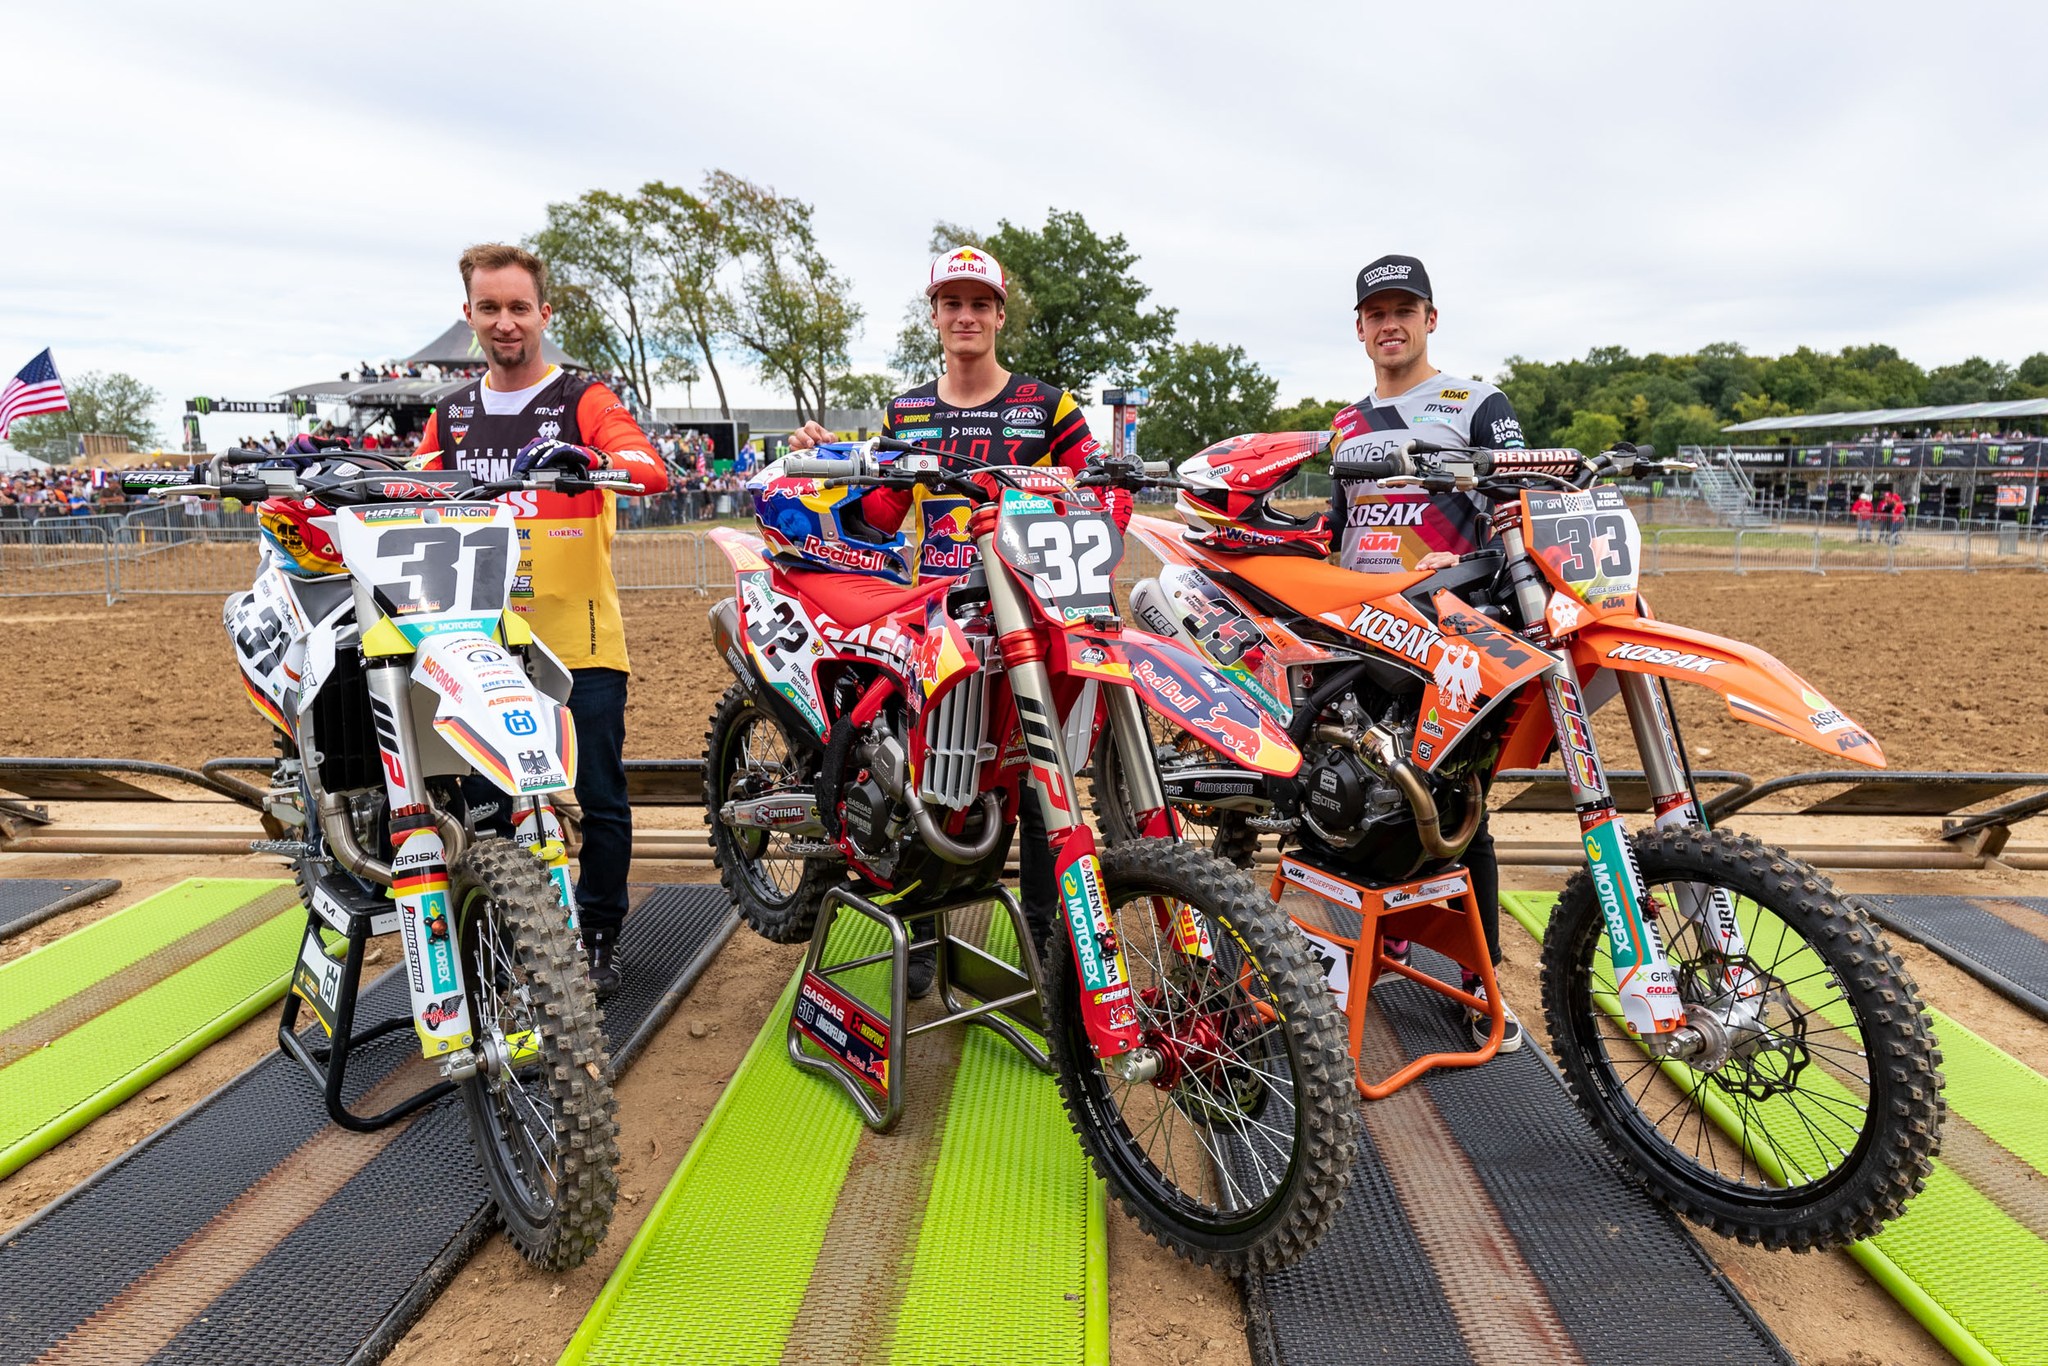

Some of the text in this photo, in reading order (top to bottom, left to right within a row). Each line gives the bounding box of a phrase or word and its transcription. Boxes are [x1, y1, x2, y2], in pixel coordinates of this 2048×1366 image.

[948, 262, 987, 275] Red Bull
[1005, 395, 1045, 404] GASGAS
[1441, 390, 1469, 400] ADAC
[218, 402, 281, 413] FINISH
[961, 410, 999, 418] DMSB
[1004, 407, 1043, 419] Airoh
[907, 429, 938, 437] MOTOREX
[962, 427, 993, 436] DEKRA
[1493, 450, 1578, 463] RENTHAL
[1774, 453, 1785, 461] IN
[125, 473, 192, 482] HAAS
[1209, 465, 1231, 479] SHOEI
[1004, 500, 1051, 509] MOTOREX
[1597, 499, 1624, 507] KOCH
[365, 507, 417, 518] HAAS
[444, 506, 490, 518] MXON
[1346, 502, 1431, 528] KOSAK
[549, 528, 583, 537] LORENC
[1358, 532, 1401, 552] KTM
[1556, 515, 1632, 583] 33
[803, 533, 885, 571] Red Bull
[923, 544, 960, 567] Red
[1027, 519, 1113, 599] 32
[374, 527, 510, 614] 31
[588, 599, 594, 611] MX
[747, 590, 762, 613] ATHENA
[1184, 596, 1203, 614] KOCH
[1602, 596, 1625, 609] KTM
[438, 621, 483, 631] MOTOREX
[588, 612, 597, 642] TRIGGER
[1145, 606, 1178, 635] HGS
[747, 601, 809, 673] 32
[1182, 598, 1264, 667] 33
[1274, 634, 1287, 648] FOX
[1348, 602, 1440, 665] KOSAK
[1081, 649, 1104, 660] Airoh
[1607, 641, 1729, 673] KOSAK
[790, 678, 811, 700] BRISK
[1133, 660, 1202, 713] Red Bull
[1244, 678, 1279, 712] MOTOREX
[793, 694, 821, 731] MOTOREX
[1422, 721, 1444, 735] ASPEN
[1547, 688, 1577, 787] SUSPENSION
[1836, 730, 1874, 751] KTM
[1000, 755, 1028, 769] SCRU
[519, 774, 563, 787] HAAS
[1194, 780, 1254, 794] BRIDGESTONE
[1657, 795, 1677, 804] WP
[1582, 812, 1601, 822] WP
[395, 851, 441, 867] BRISK
[1288, 867, 1345, 895] KTM POWERPARTS
[1083, 869, 1103, 919] ATHENA
[1392, 890, 1411, 903] KTM
[1591, 863, 1632, 955] MOTOREX
[402, 903, 425, 993] BRIDGESTONE
[1067, 897, 1101, 986] MOTOREX
[437, 938, 451, 985] TOREX
[1218, 915, 1287, 1022] PIRELLI
[802, 984, 845, 1022] GASGAS
[1094, 987, 1130, 1005] SCRUB
